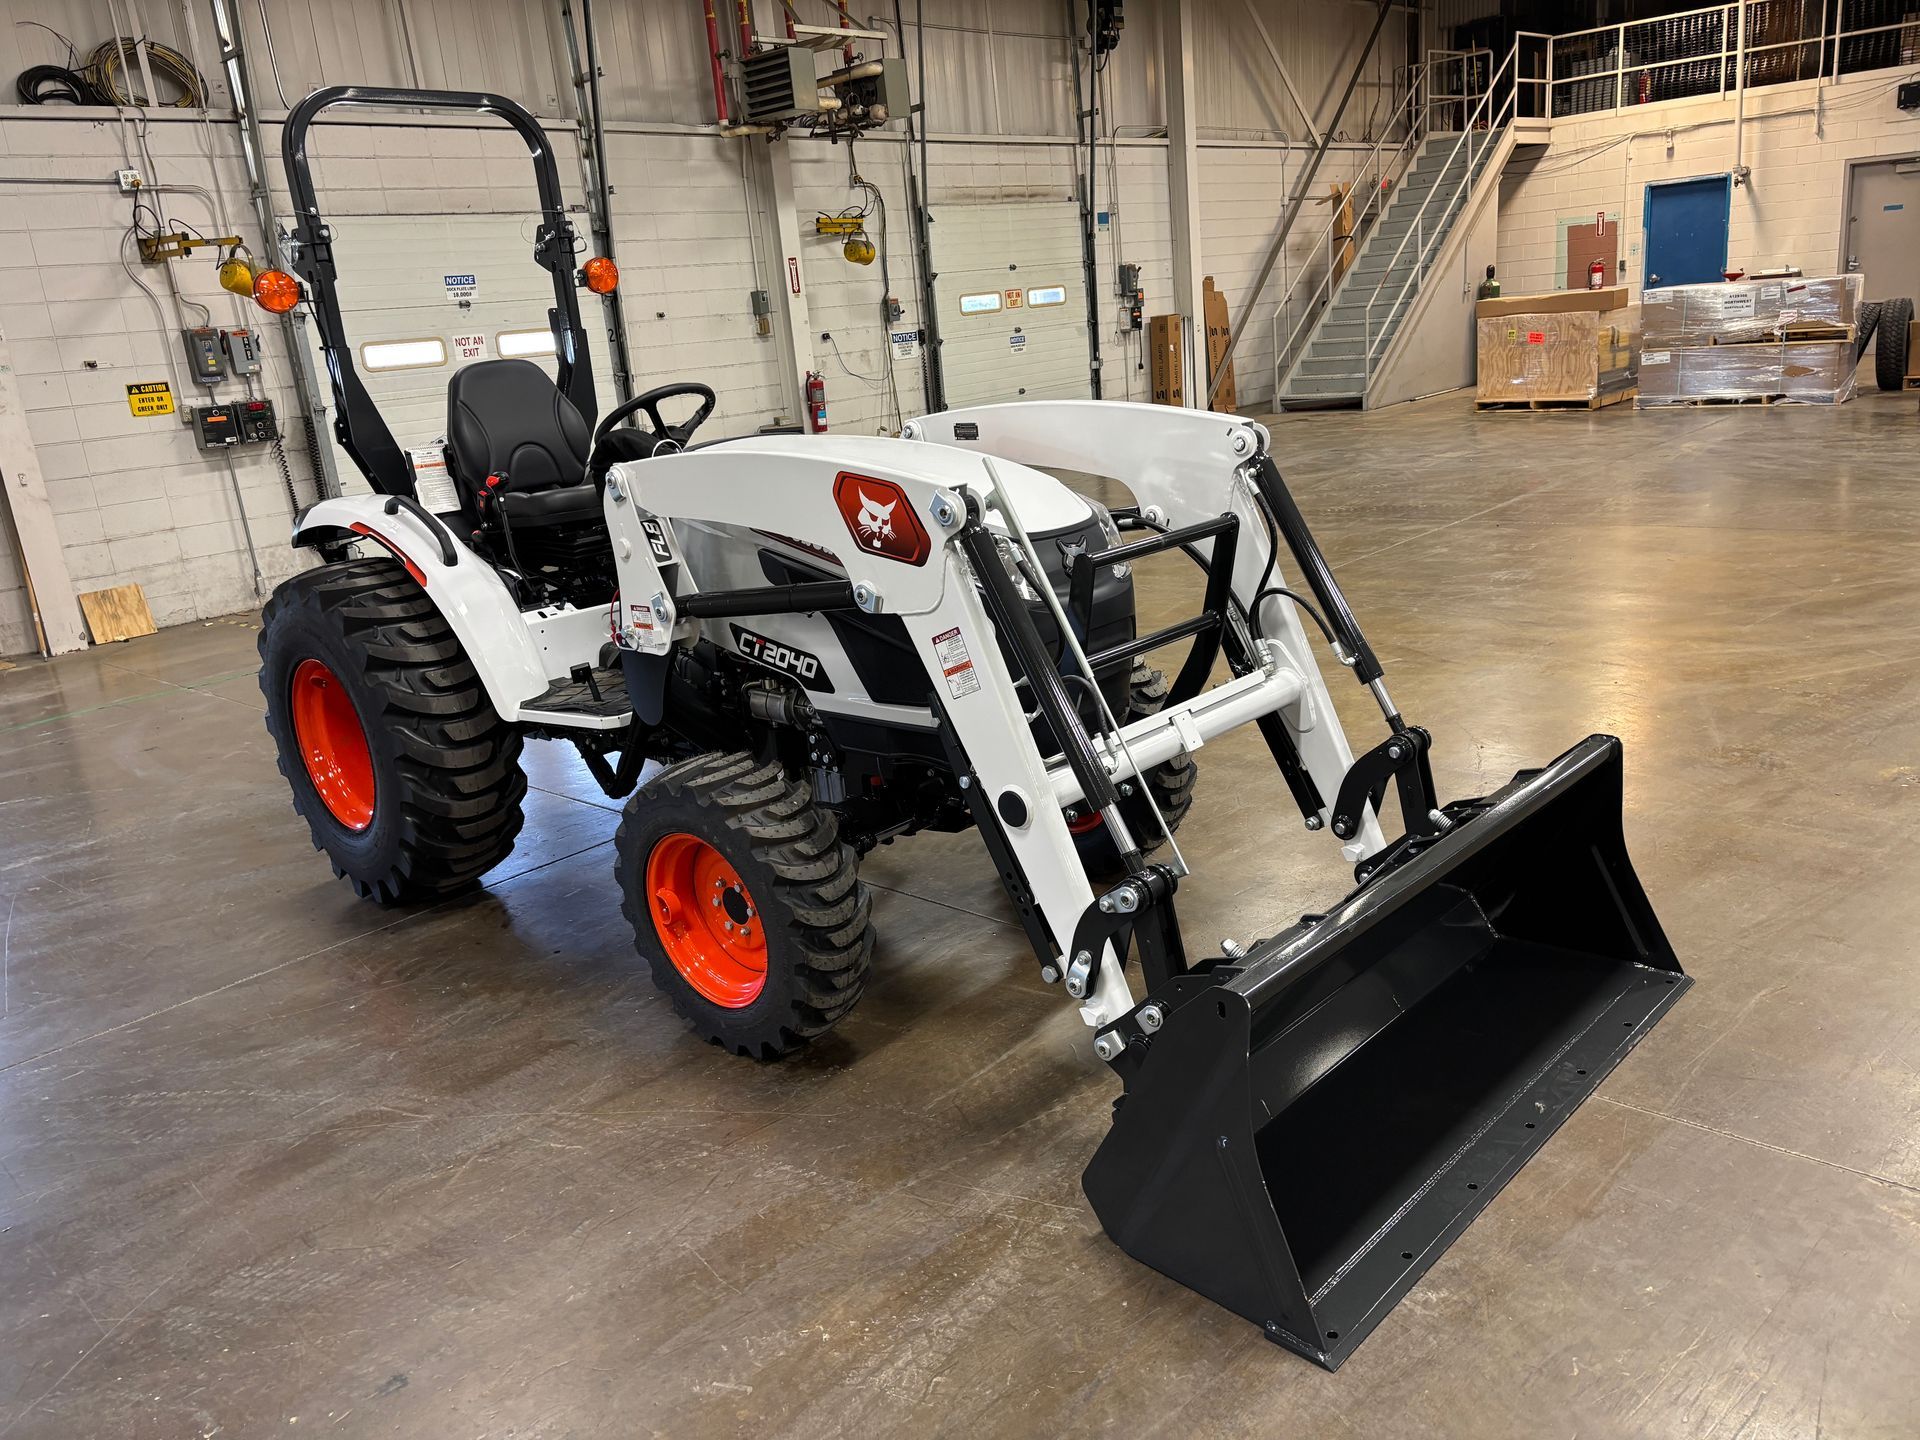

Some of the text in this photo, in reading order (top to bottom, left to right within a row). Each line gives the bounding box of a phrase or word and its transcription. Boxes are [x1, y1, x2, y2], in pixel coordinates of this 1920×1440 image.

[446, 276, 474, 285] NOTICE
[455, 335, 484, 346] NOT AN
[607, 328, 616, 342] 2
[893, 332, 917, 342] NOTICE
[463, 347, 480, 357] EXIT
[140, 384, 167, 393] CAUTION
[643, 522, 670, 557] FL8
[940, 629, 958, 641] DANGER
[738, 632, 818, 679] CT2040
